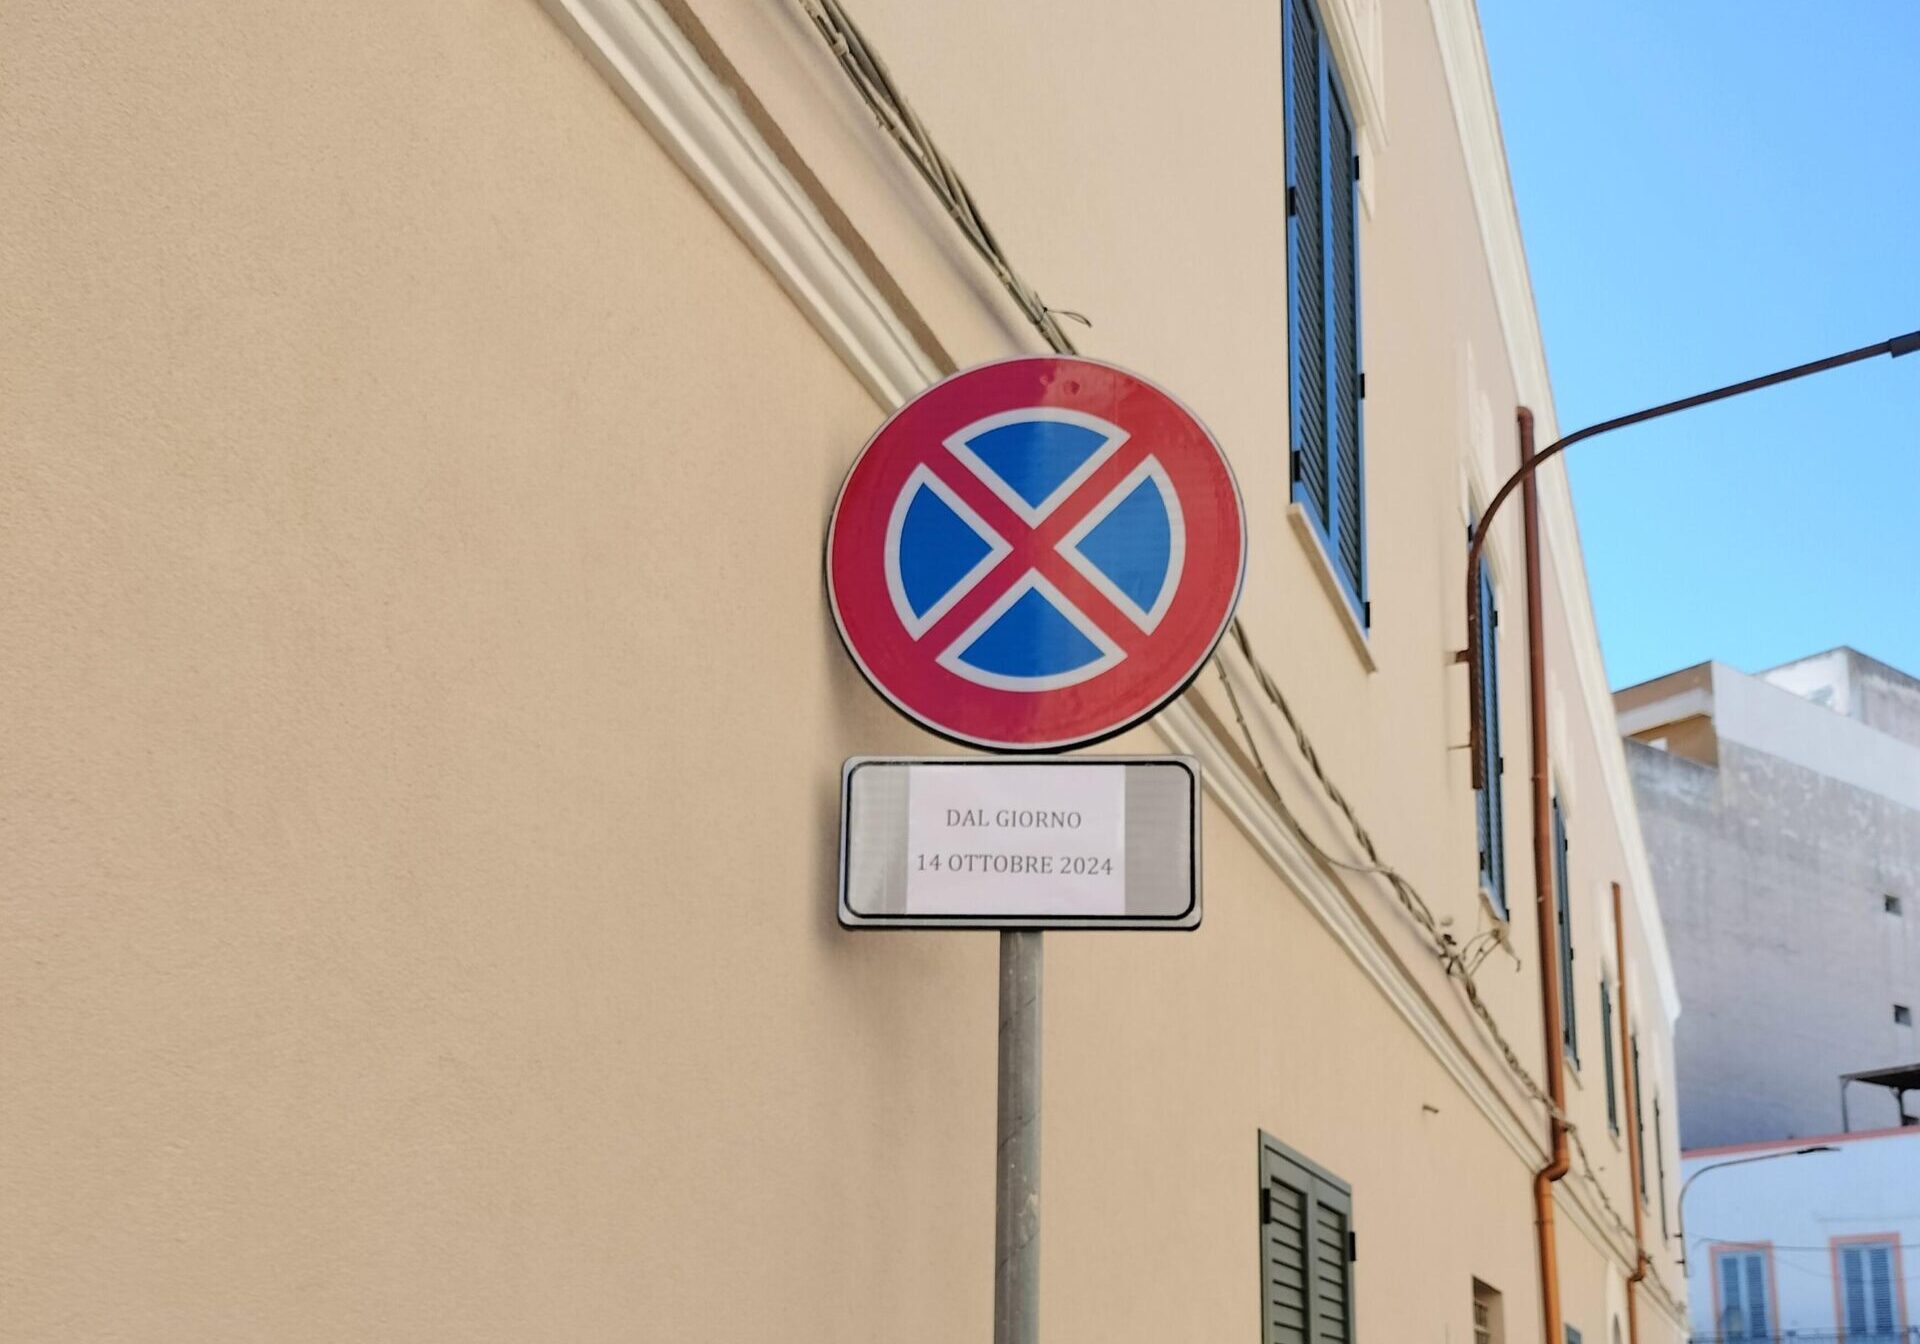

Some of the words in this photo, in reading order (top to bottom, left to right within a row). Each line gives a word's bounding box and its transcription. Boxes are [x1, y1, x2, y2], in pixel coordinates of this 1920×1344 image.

[946, 809, 990, 828] DAL
[996, 809, 1083, 829] GIORNO
[917, 854, 943, 872] 14
[948, 854, 1054, 875] OTTOBRE
[1060, 856, 1114, 876] 2024
